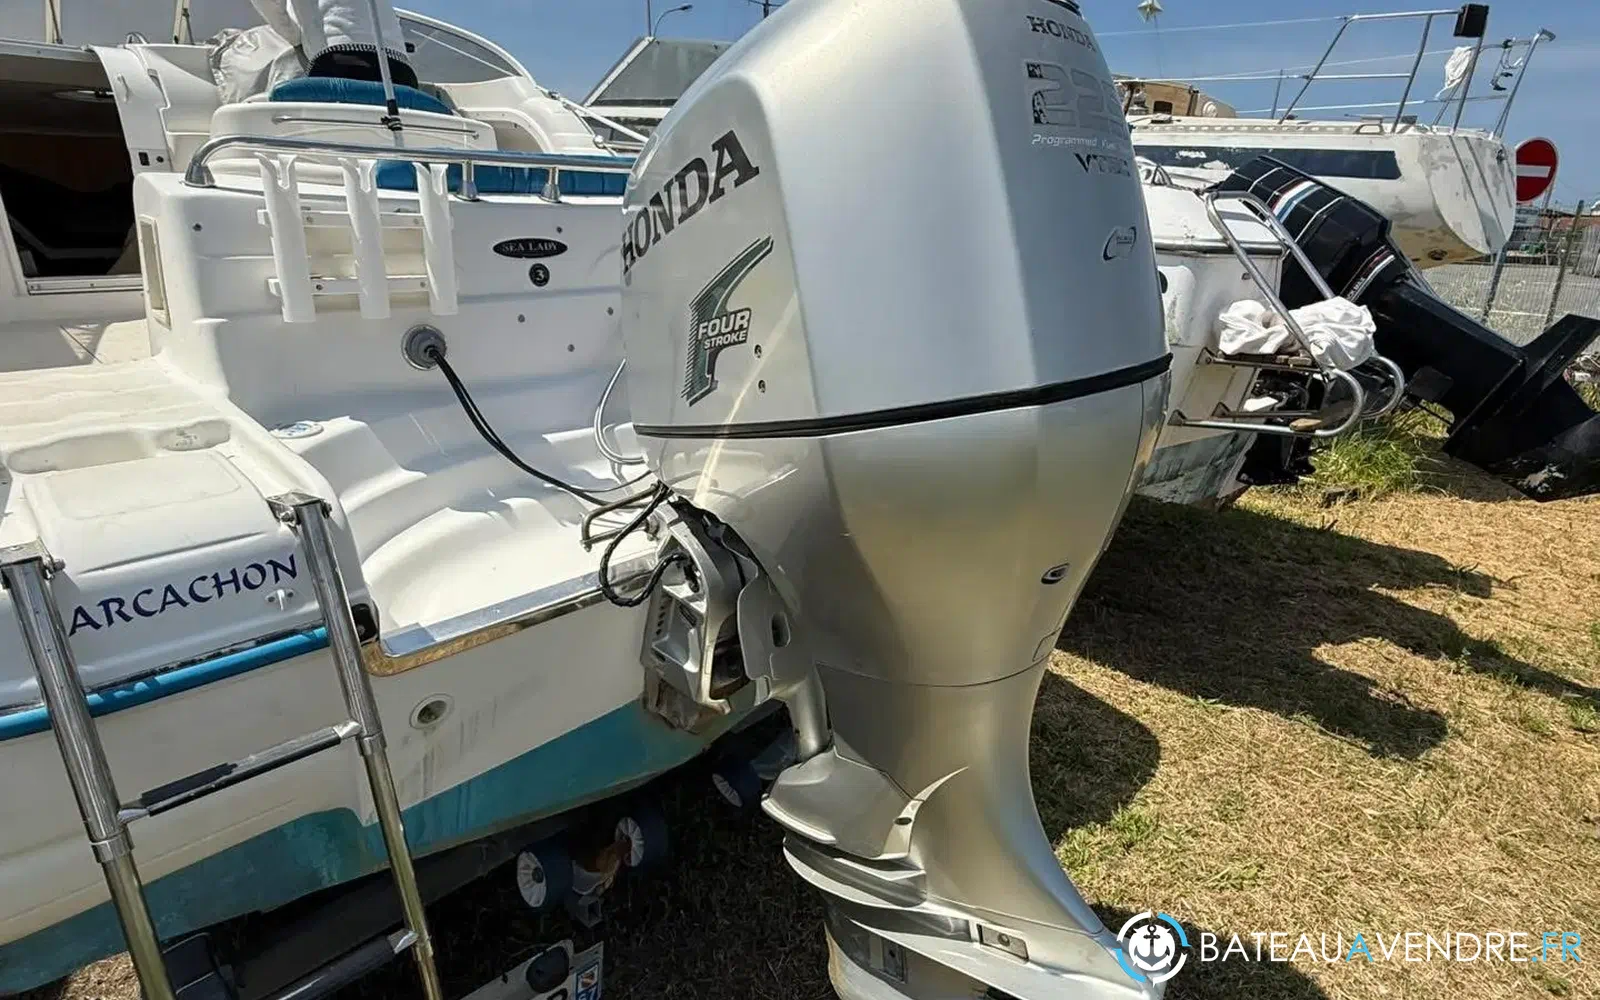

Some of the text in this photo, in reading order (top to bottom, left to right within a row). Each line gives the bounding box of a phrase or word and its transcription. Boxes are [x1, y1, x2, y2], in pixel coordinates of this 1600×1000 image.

[1026, 15, 1096, 51] HONDA
[621, 129, 760, 276] HONDA
[502, 242, 558, 252] SEA LADY
[698, 309, 751, 340] FOUR
[704, 330, 748, 350] STROKE
[69, 553, 298, 637] ARCACHON
